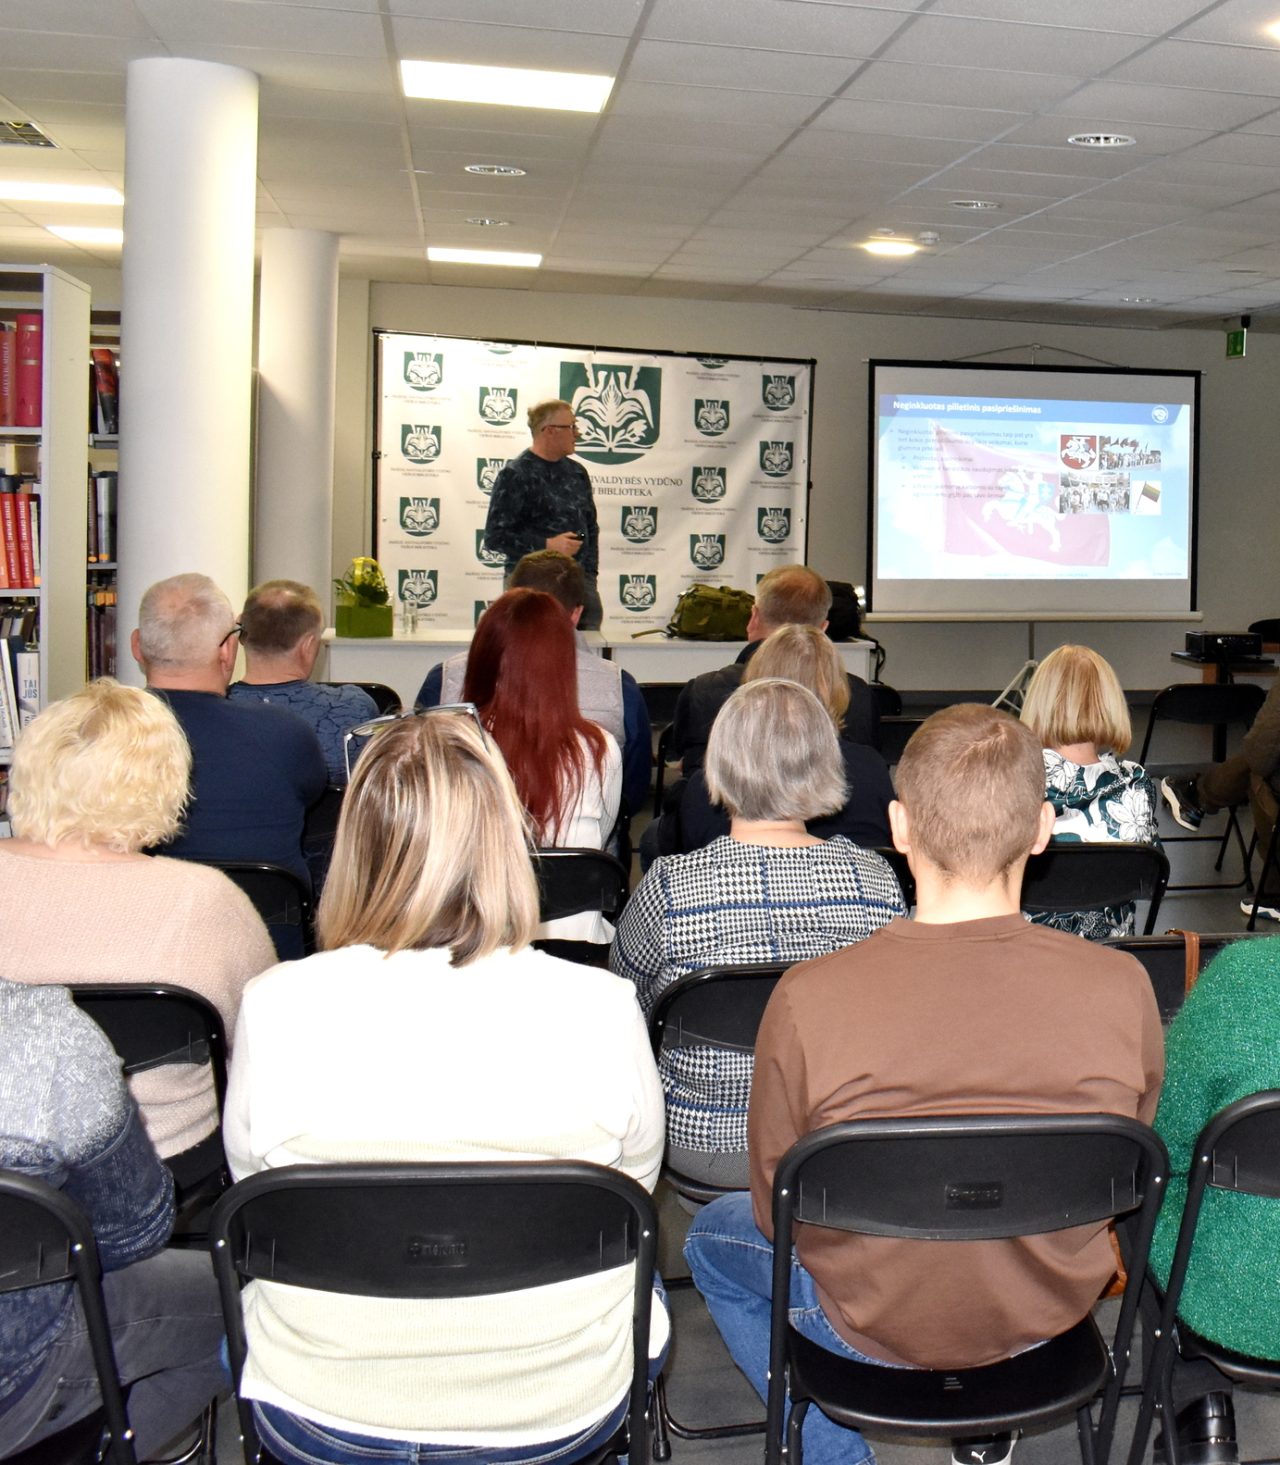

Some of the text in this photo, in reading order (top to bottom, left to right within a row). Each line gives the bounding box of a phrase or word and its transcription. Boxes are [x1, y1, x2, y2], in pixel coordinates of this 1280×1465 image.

[893, 401, 1042, 415] Neginkluotas pilietinis pasipriešinimas
[590, 475, 683, 487] IVALDYBĖS VYDŪNO
[598, 487, 653, 496] BIBLIOTEKA
